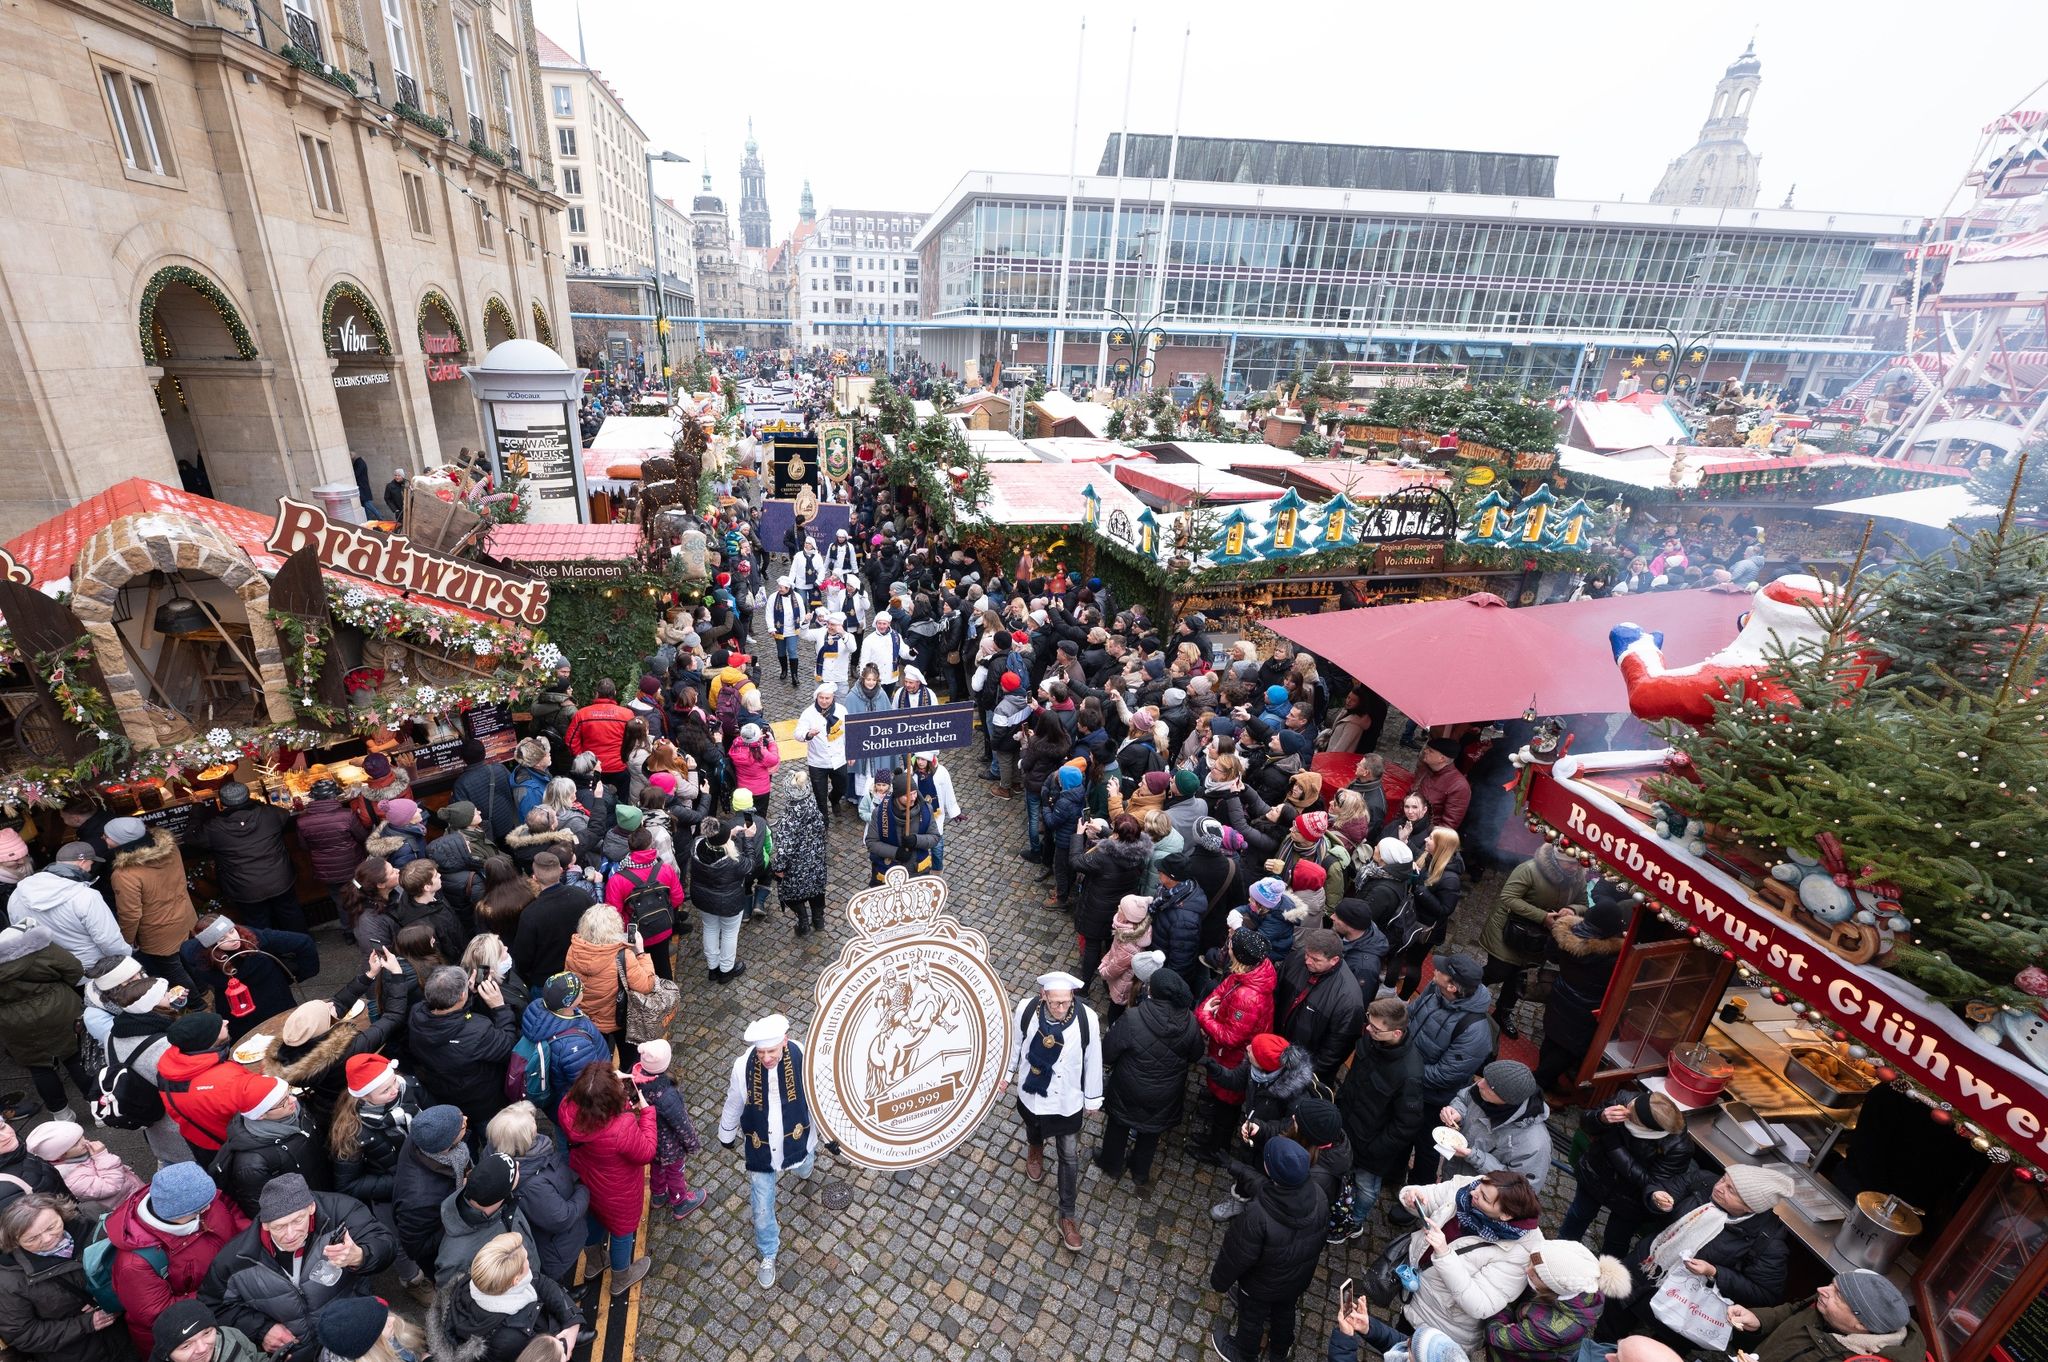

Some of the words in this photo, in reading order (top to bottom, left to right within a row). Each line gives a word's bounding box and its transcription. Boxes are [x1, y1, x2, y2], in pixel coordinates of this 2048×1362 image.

[339, 316, 368, 352] Viba
[334, 373, 389, 387] ERLEBNIS-CONFISERIE
[504, 439, 560, 449] SCHWARZ
[530, 450, 564, 460] WEISS
[271, 498, 550, 623] Bratwurst
[561, 566, 621, 576] Maronen
[869, 726, 893, 736] Das
[897, 719, 951, 733] Dresdner
[432, 740, 463, 752] POMMES
[862, 733, 957, 751] Stollenmädchen
[1567, 803, 1808, 982] Rostbratwurst
[819, 966, 877, 1056] Schutzverband
[880, 948, 944, 967] Dresdner
[947, 953, 982, 988] Stollen
[891, 1091, 940, 1116] 999.999
[890, 1104, 944, 1128] Qualitätssiegel
[864, 1108, 975, 1157] www.dresdnerstollen.com
[1851, 1223, 1878, 1245] enf
[1665, 1288, 1688, 1305] Emil
[1688, 1302, 1725, 1328] Reimann
